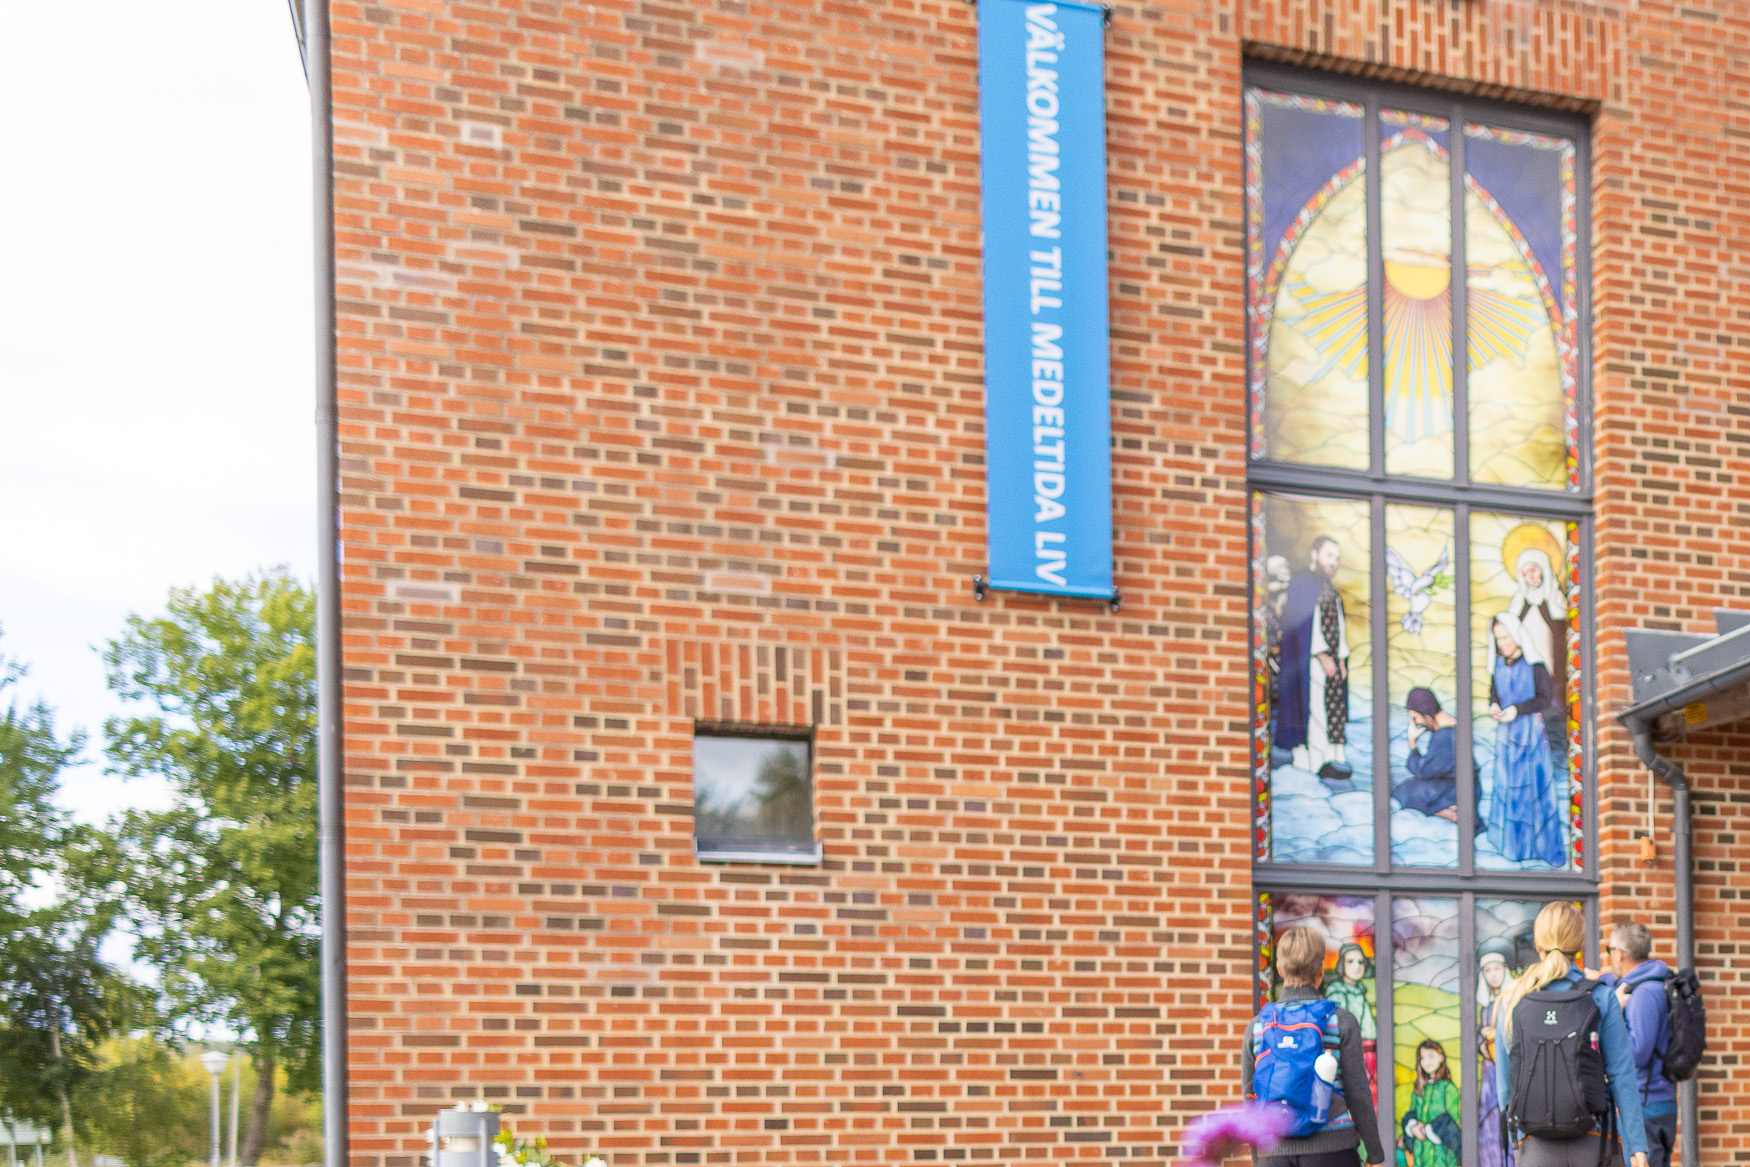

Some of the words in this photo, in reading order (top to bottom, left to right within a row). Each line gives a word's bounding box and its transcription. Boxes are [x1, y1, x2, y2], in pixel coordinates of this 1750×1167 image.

[1025, 3, 1066, 239] VÄLKOMMEN
[1029, 246, 1063, 316] TILL
[1031, 322, 1066, 523] MEDELTIDA
[1035, 531, 1067, 588] LIV
